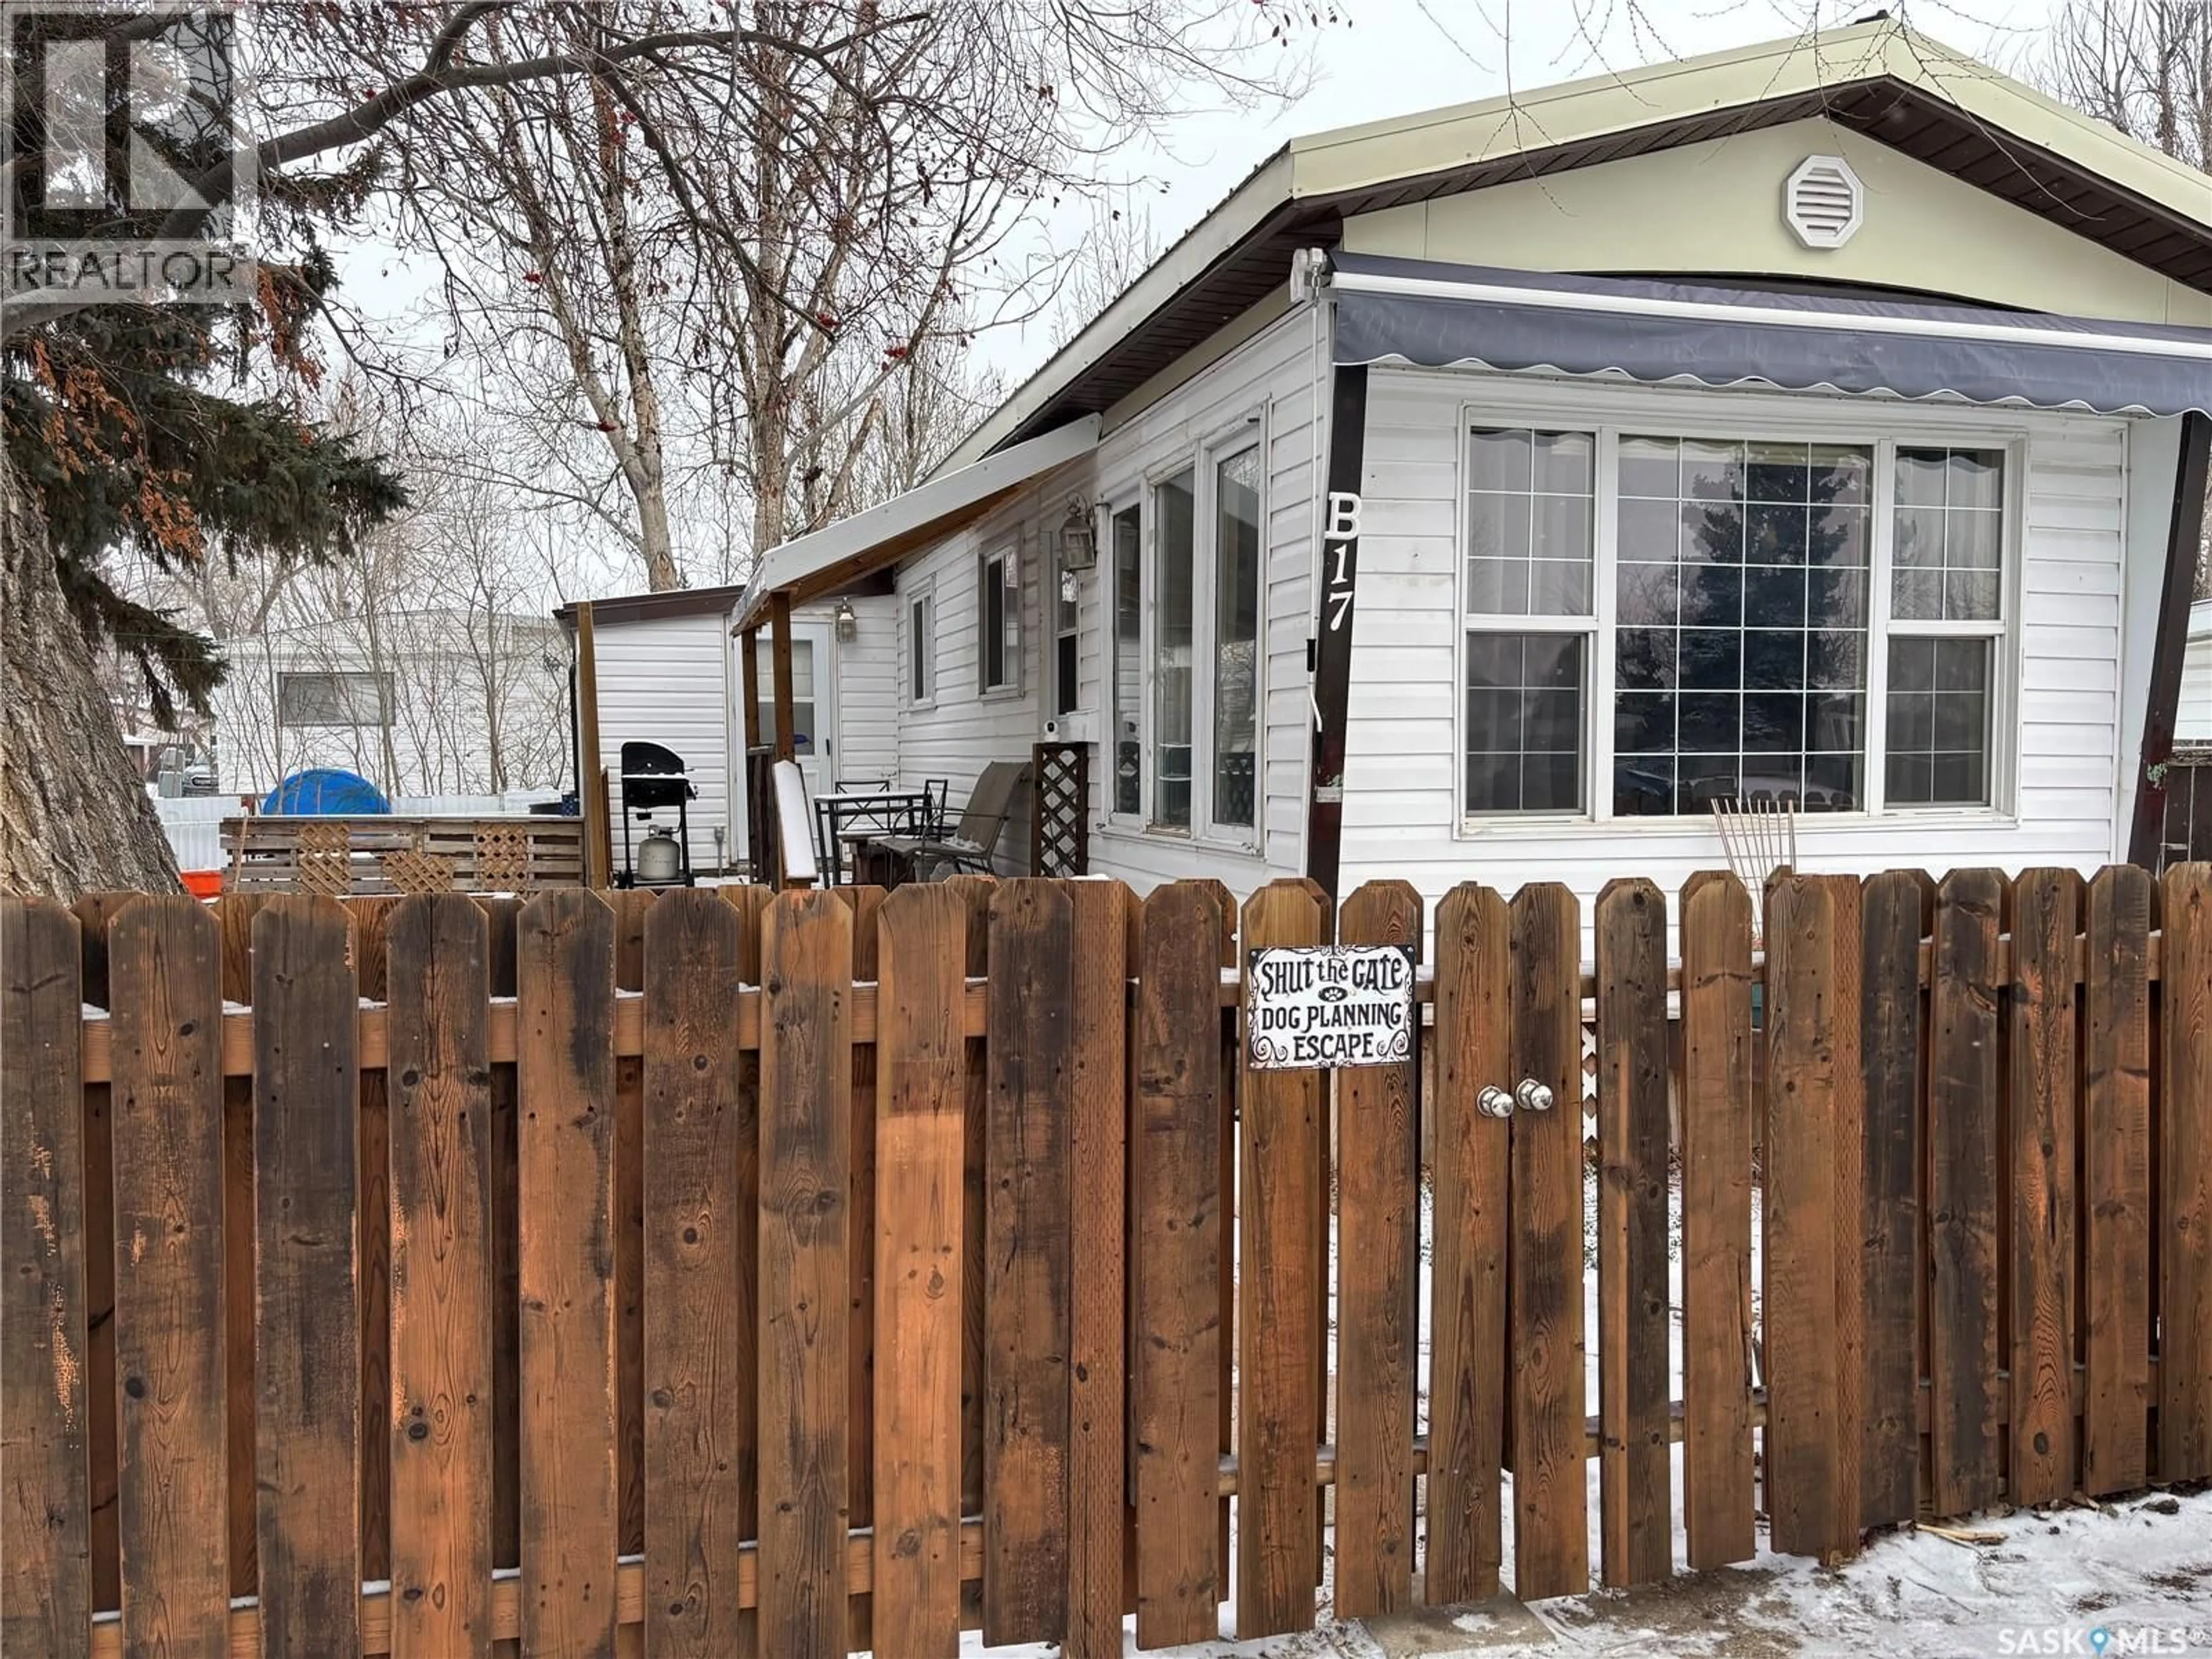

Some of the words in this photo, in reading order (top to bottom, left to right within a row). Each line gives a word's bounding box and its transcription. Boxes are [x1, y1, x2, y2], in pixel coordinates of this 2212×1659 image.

[1317, 958, 1349, 984] the
[1262, 1006, 1300, 1031] DOG
[1301, 1002, 1402, 1033] PLANNING
[1293, 1033, 1374, 1061] ESCAPE
